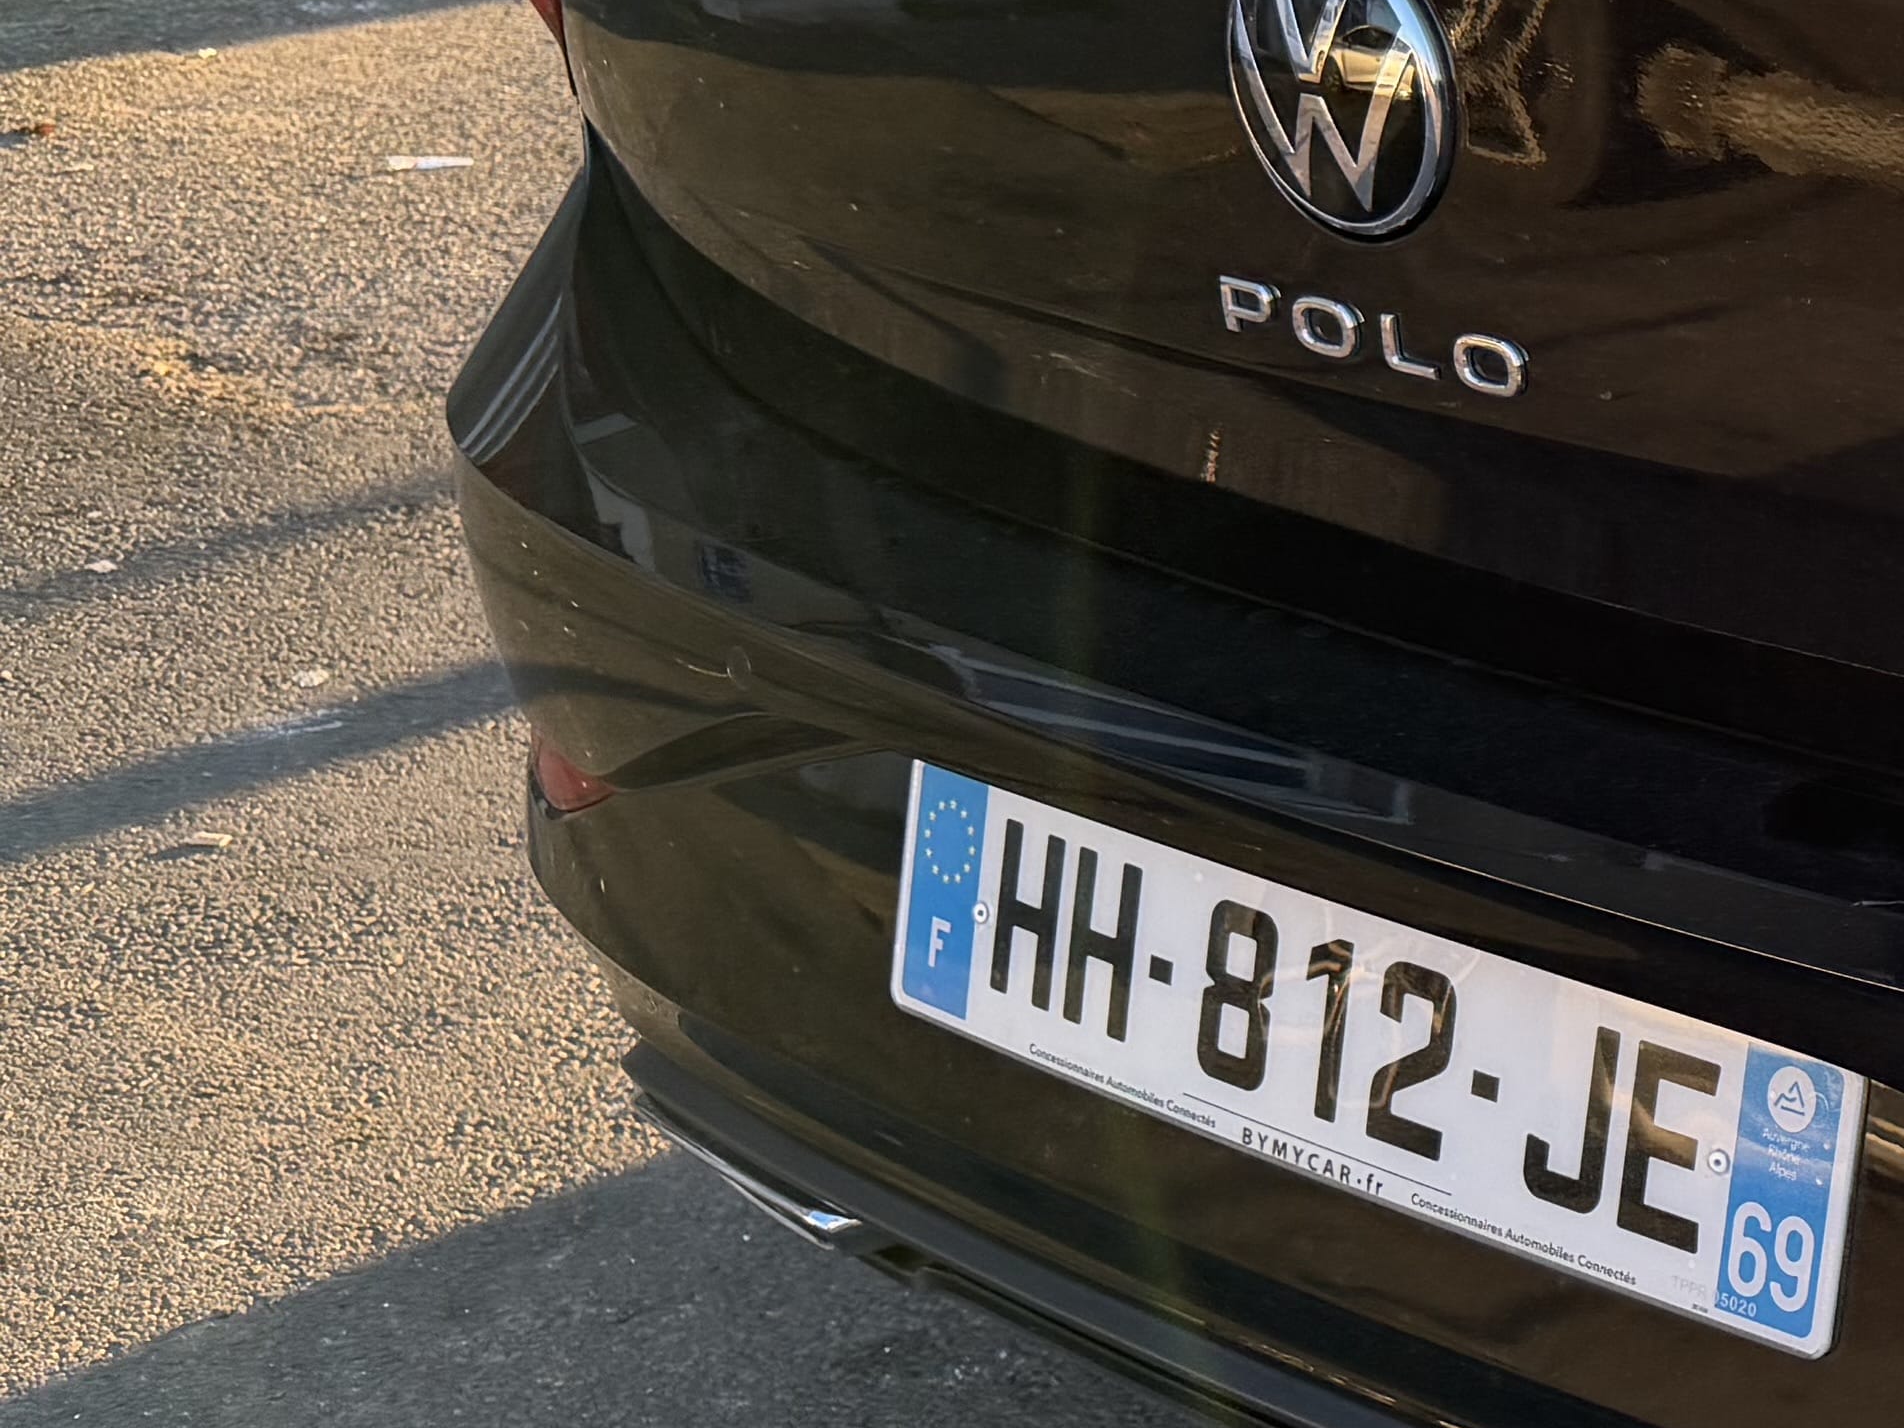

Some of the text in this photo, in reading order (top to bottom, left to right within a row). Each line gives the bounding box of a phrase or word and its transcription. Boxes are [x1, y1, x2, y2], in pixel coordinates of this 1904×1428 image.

[1219, 275, 1529, 397] POLO
[927, 915, 952, 968] F
[990, 818, 1721, 1255] HH-812-JE
[1029, 1042, 1216, 1128] Concessionnaires Automobiles Connectés
[1768, 1161, 1798, 1181] Alpes
[1411, 1192, 1637, 1286] Concessionnaires Automobiles Connectés
[1727, 1201, 1815, 1312] 69
